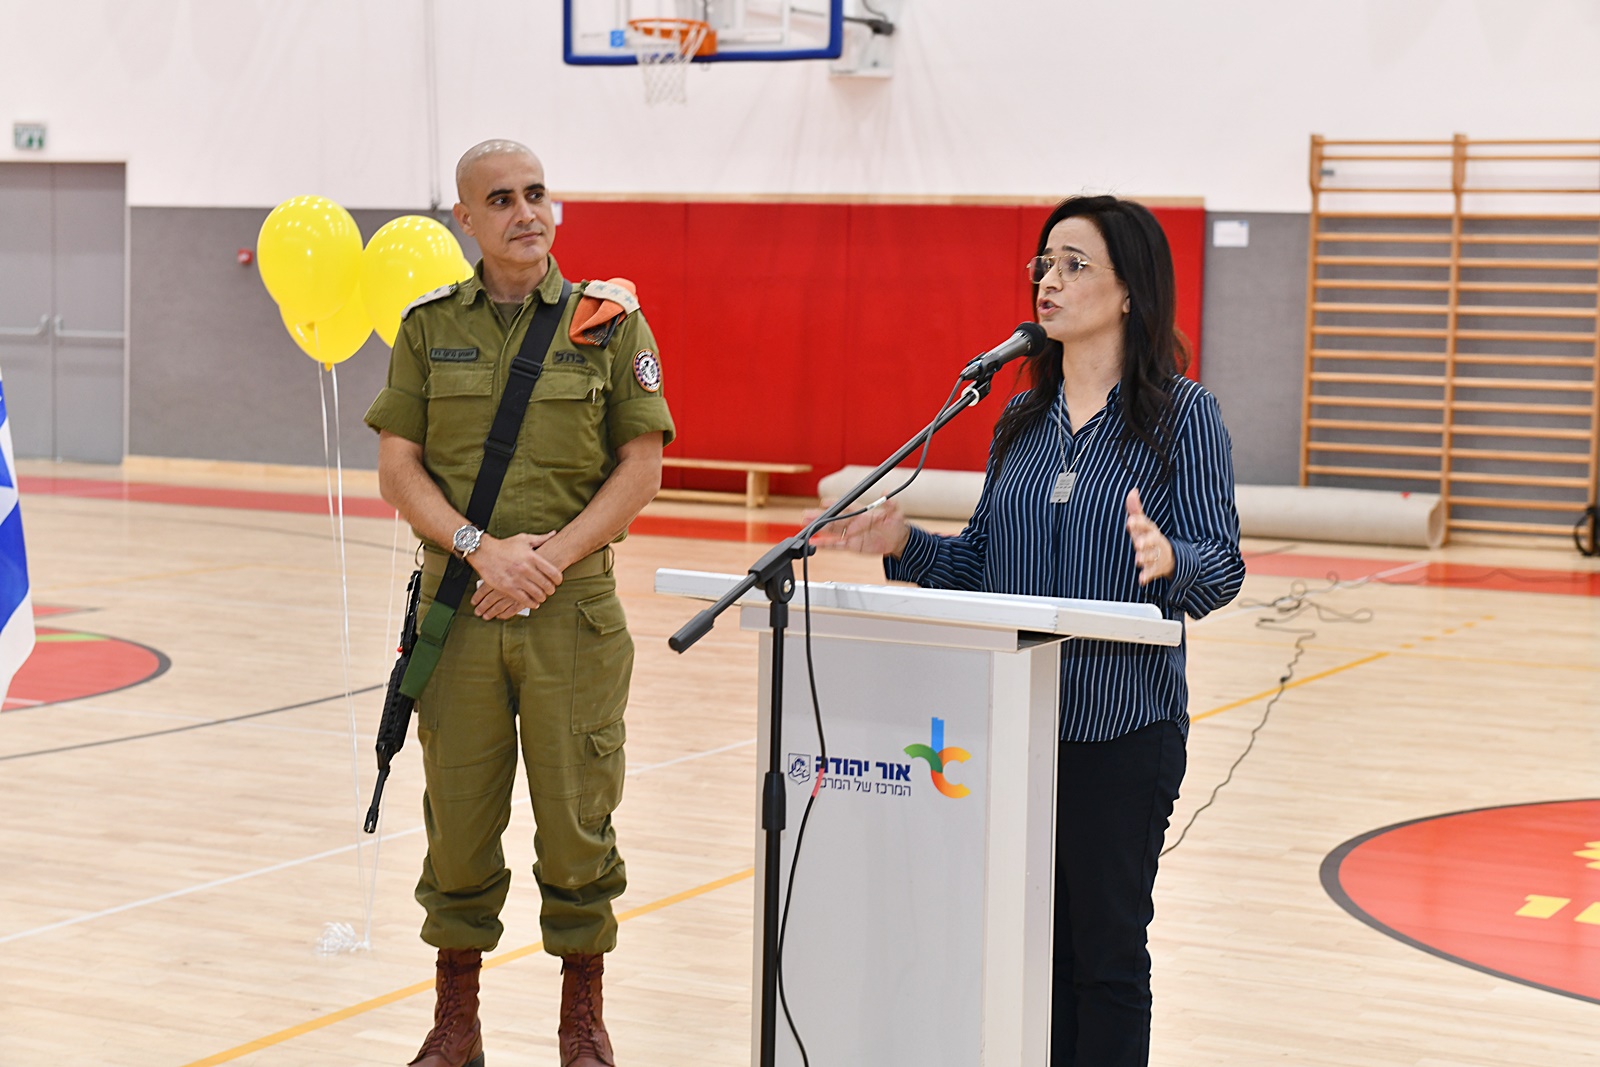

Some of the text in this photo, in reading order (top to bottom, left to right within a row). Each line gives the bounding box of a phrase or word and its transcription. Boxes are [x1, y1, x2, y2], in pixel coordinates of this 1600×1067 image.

[815, 755, 912, 782] אור יהודה
[815, 776, 912, 797] המרכז של המרכ
